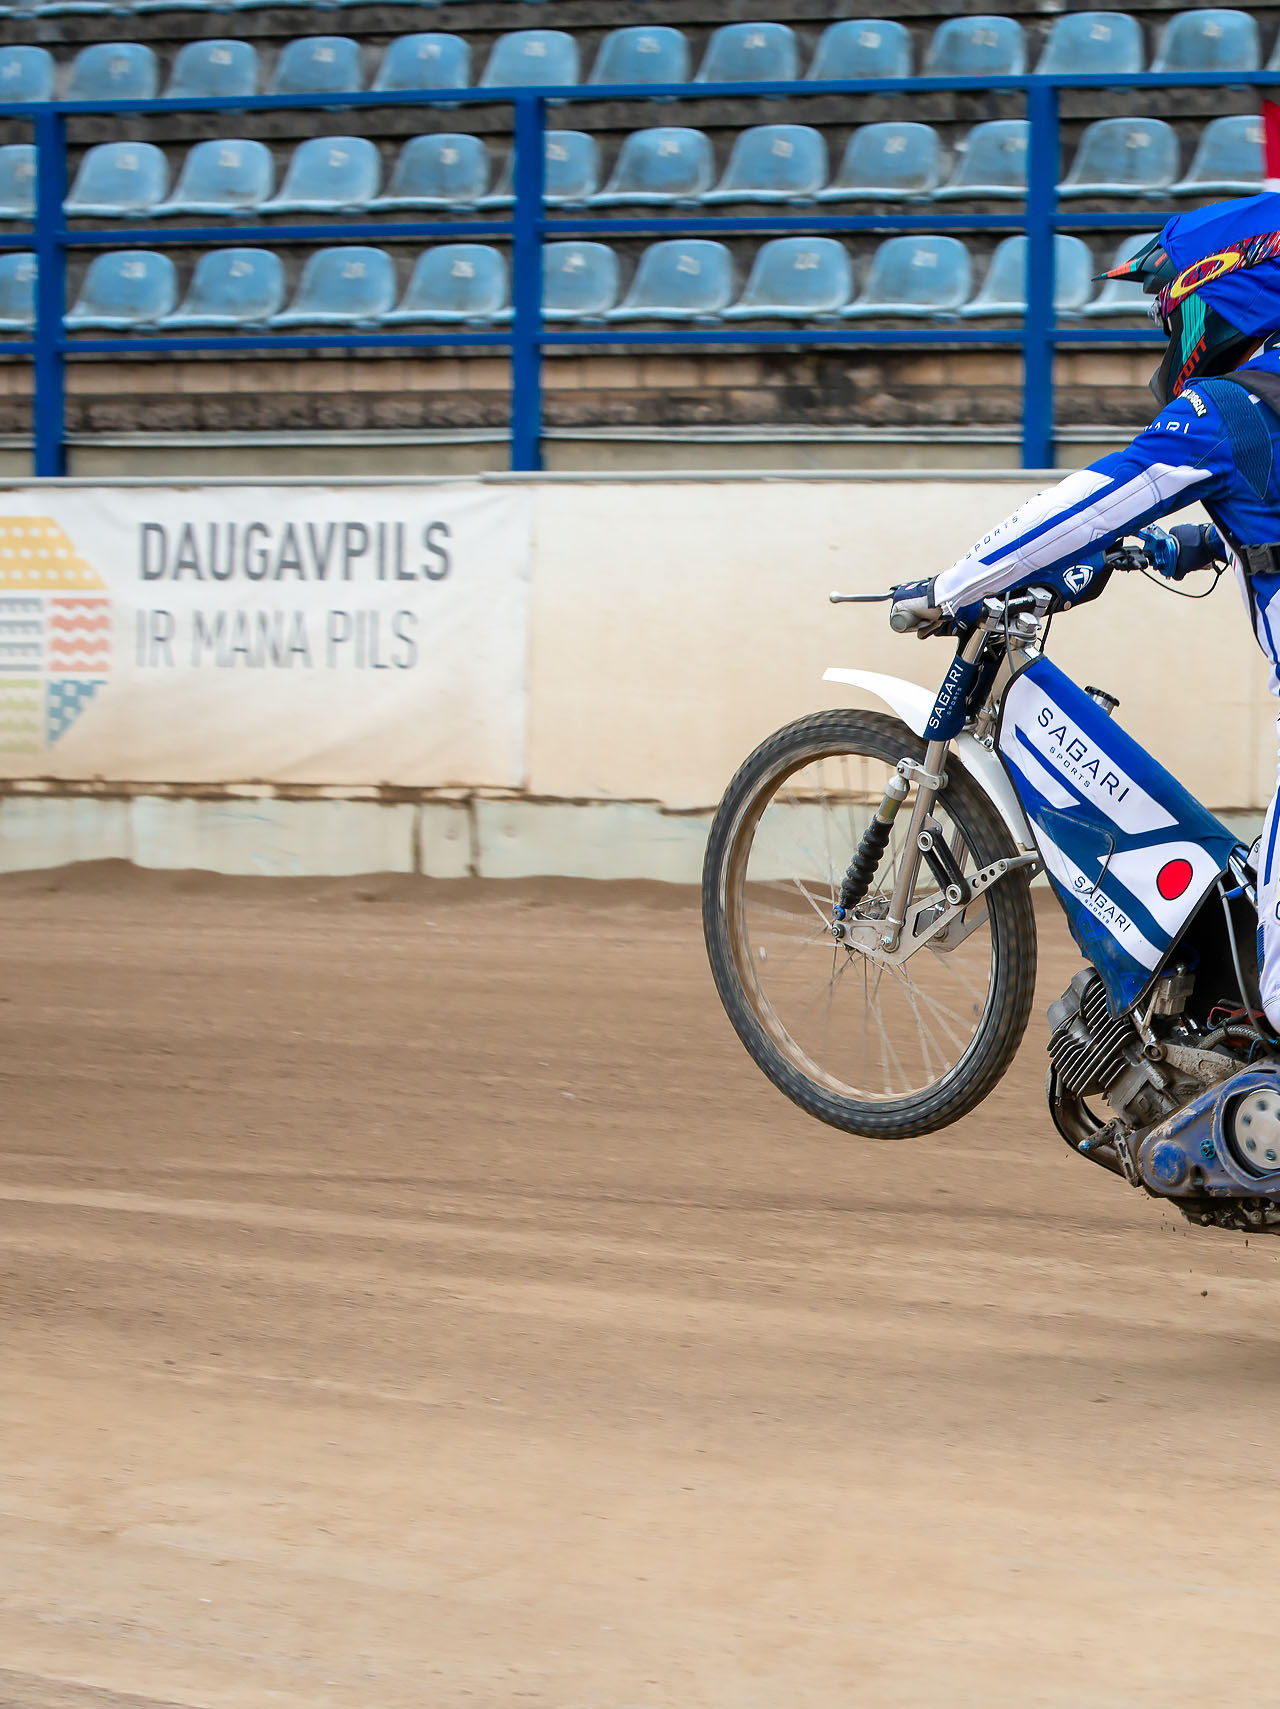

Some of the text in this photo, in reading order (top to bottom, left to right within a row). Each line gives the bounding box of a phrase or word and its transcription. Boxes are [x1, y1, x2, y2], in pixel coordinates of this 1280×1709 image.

[1173, 335, 1208, 398] SCOTT
[139, 521, 453, 582] DAUGAVPILS
[134, 609, 419, 670] IR MANA PILS
[929, 663, 964, 730] SAGARI
[1037, 707, 1130, 803] SAGARI
[1049, 746, 1091, 788] SPORTS
[1074, 875, 1131, 933] SAGARI
